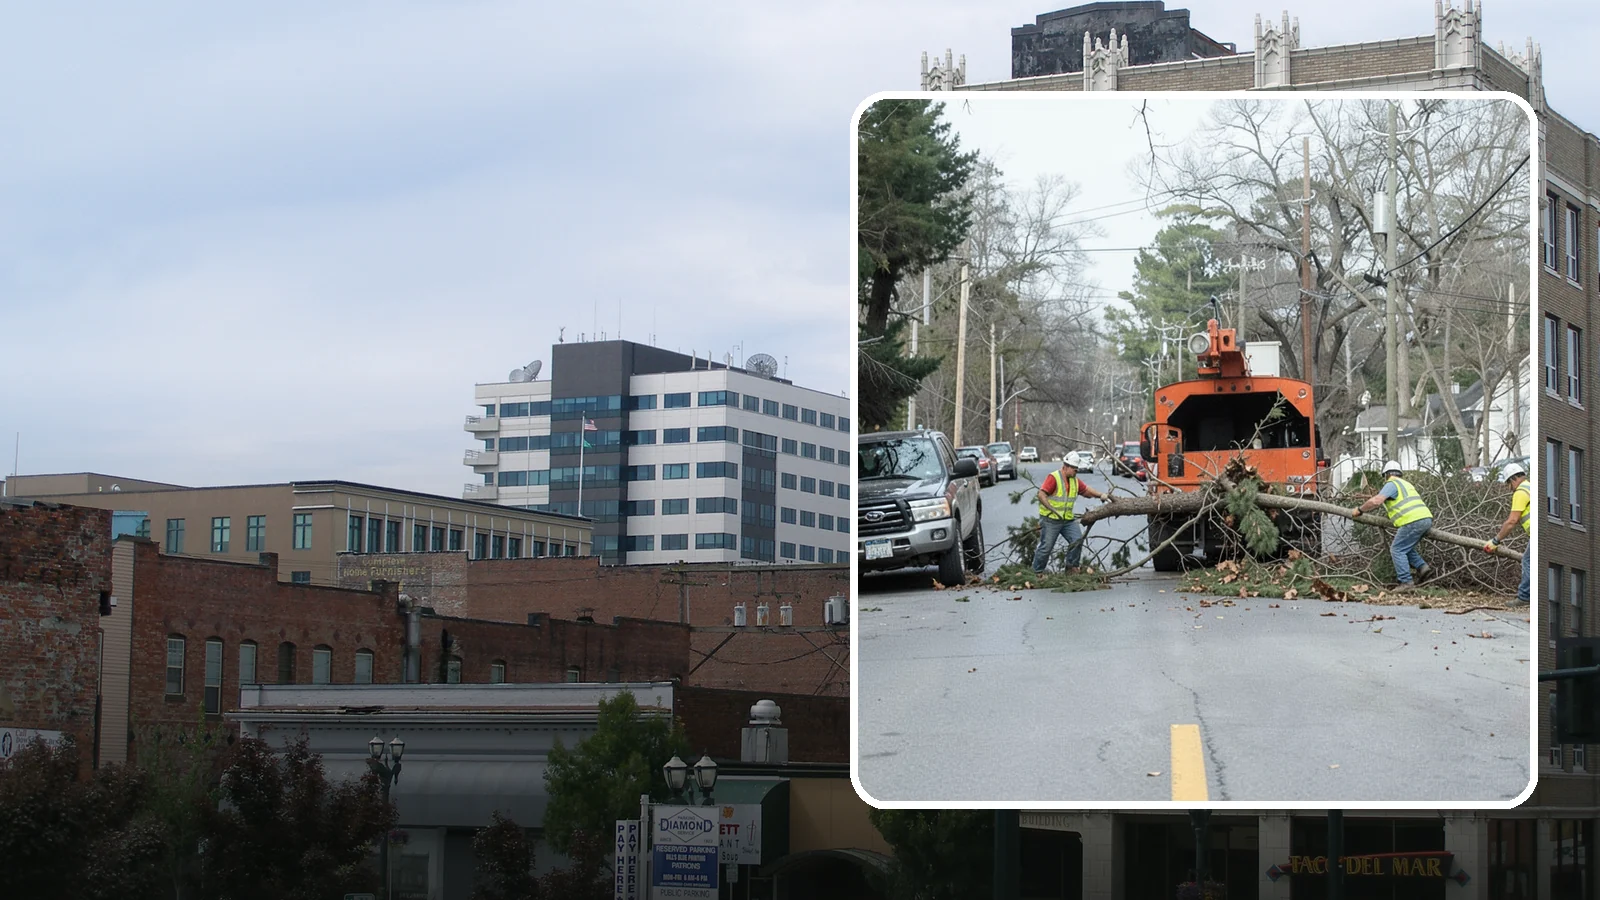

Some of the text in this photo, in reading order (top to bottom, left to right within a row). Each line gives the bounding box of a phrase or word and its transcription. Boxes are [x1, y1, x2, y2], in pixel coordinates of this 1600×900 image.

[370, 566, 426, 577] Furnishers
[660, 818, 713, 833] DIAMOND
[1021, 815, 1070, 828] BUILDING
[656, 845, 716, 854] RESERVED PARKING
[616, 824, 625, 894] PAY HERE
[627, 824, 637, 894] PAY HERE
[722, 851, 739, 862] Soup
[671, 862, 701, 870] PATRONS
[1289, 855, 1443, 877] TAC DEL MAR
[660, 889, 710, 898] PUBLIC PARKING
